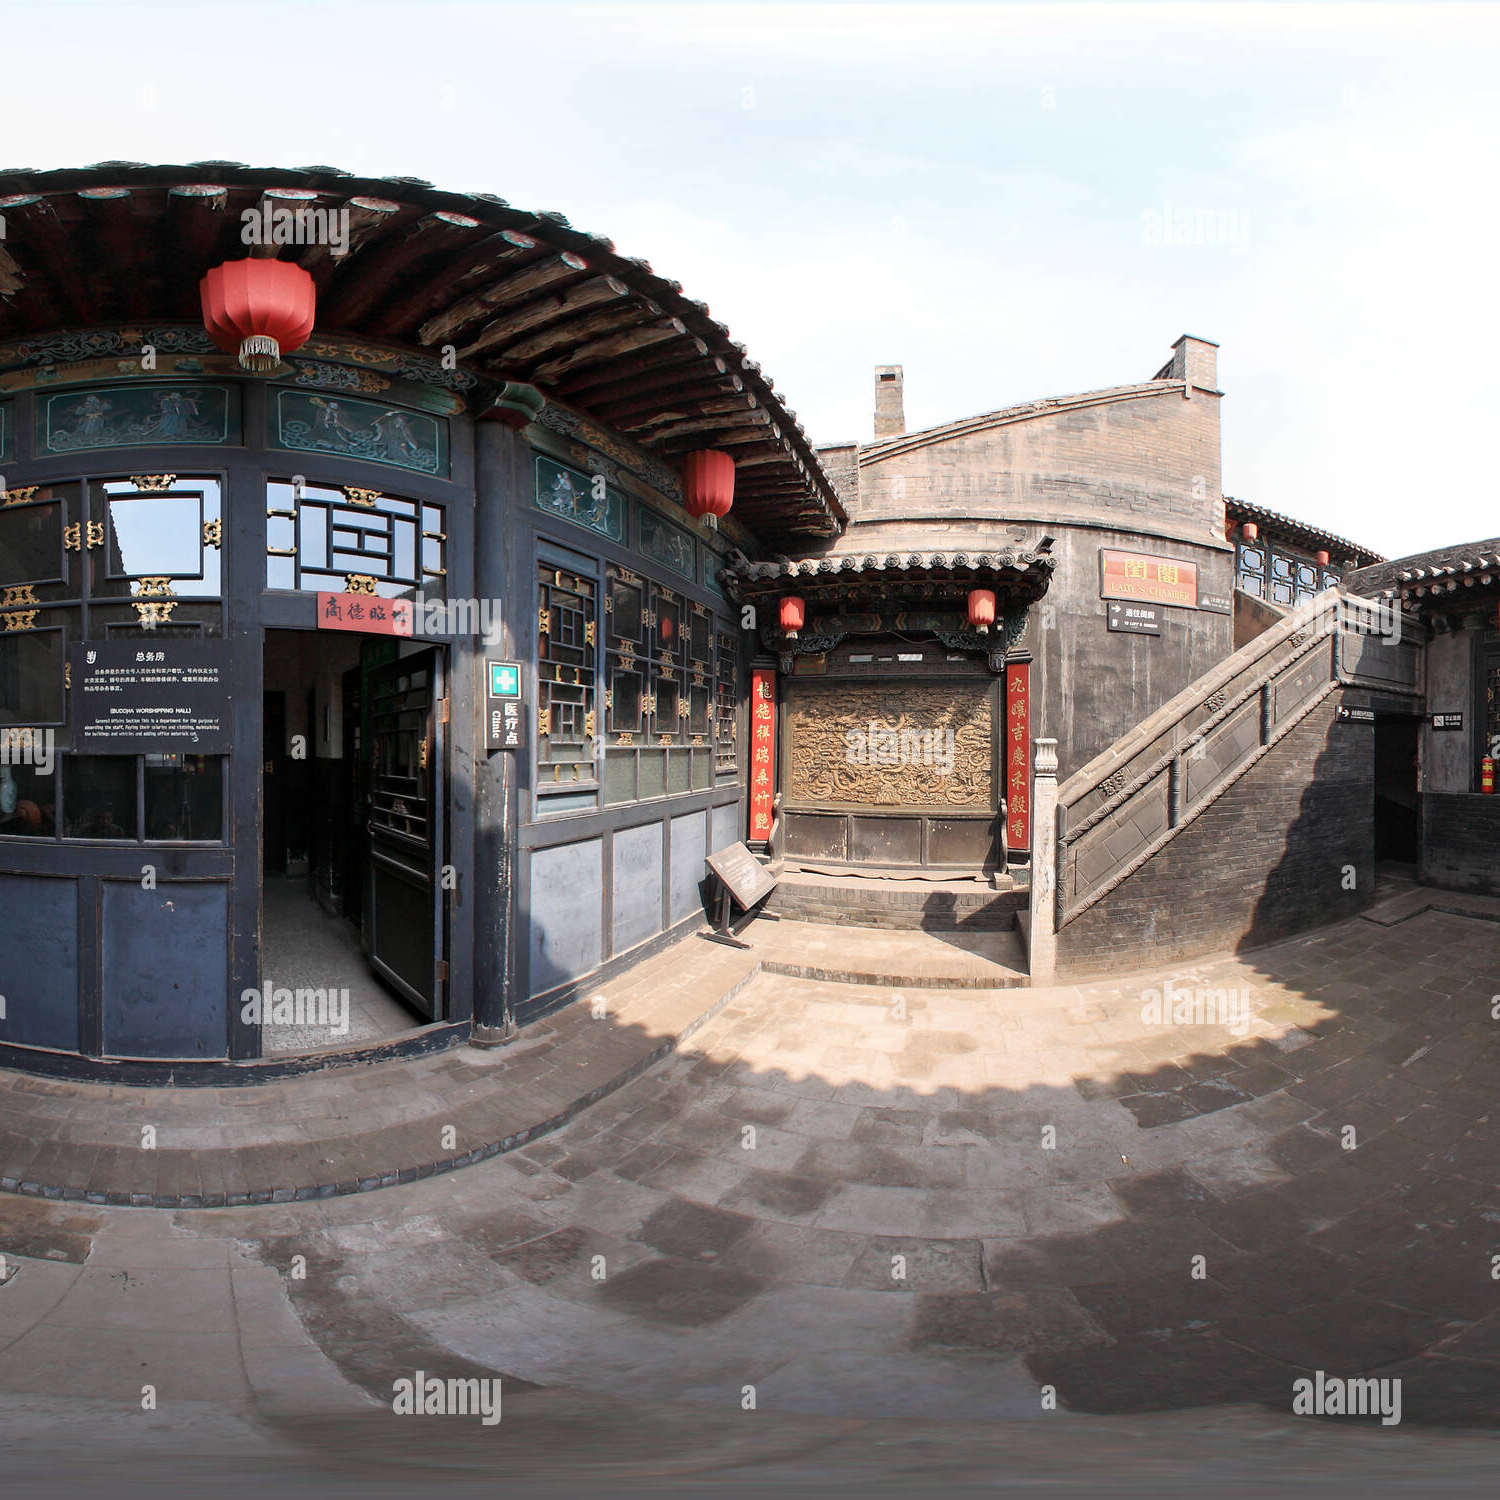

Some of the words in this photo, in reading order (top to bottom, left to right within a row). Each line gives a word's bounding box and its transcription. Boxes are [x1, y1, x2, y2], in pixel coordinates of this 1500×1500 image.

[1149, 586, 1190, 601] CHAMBER
[135, 651, 166, 662] 总务房
[491, 710, 502, 739] Clinic
[504, 702, 519, 745] 医疗点
